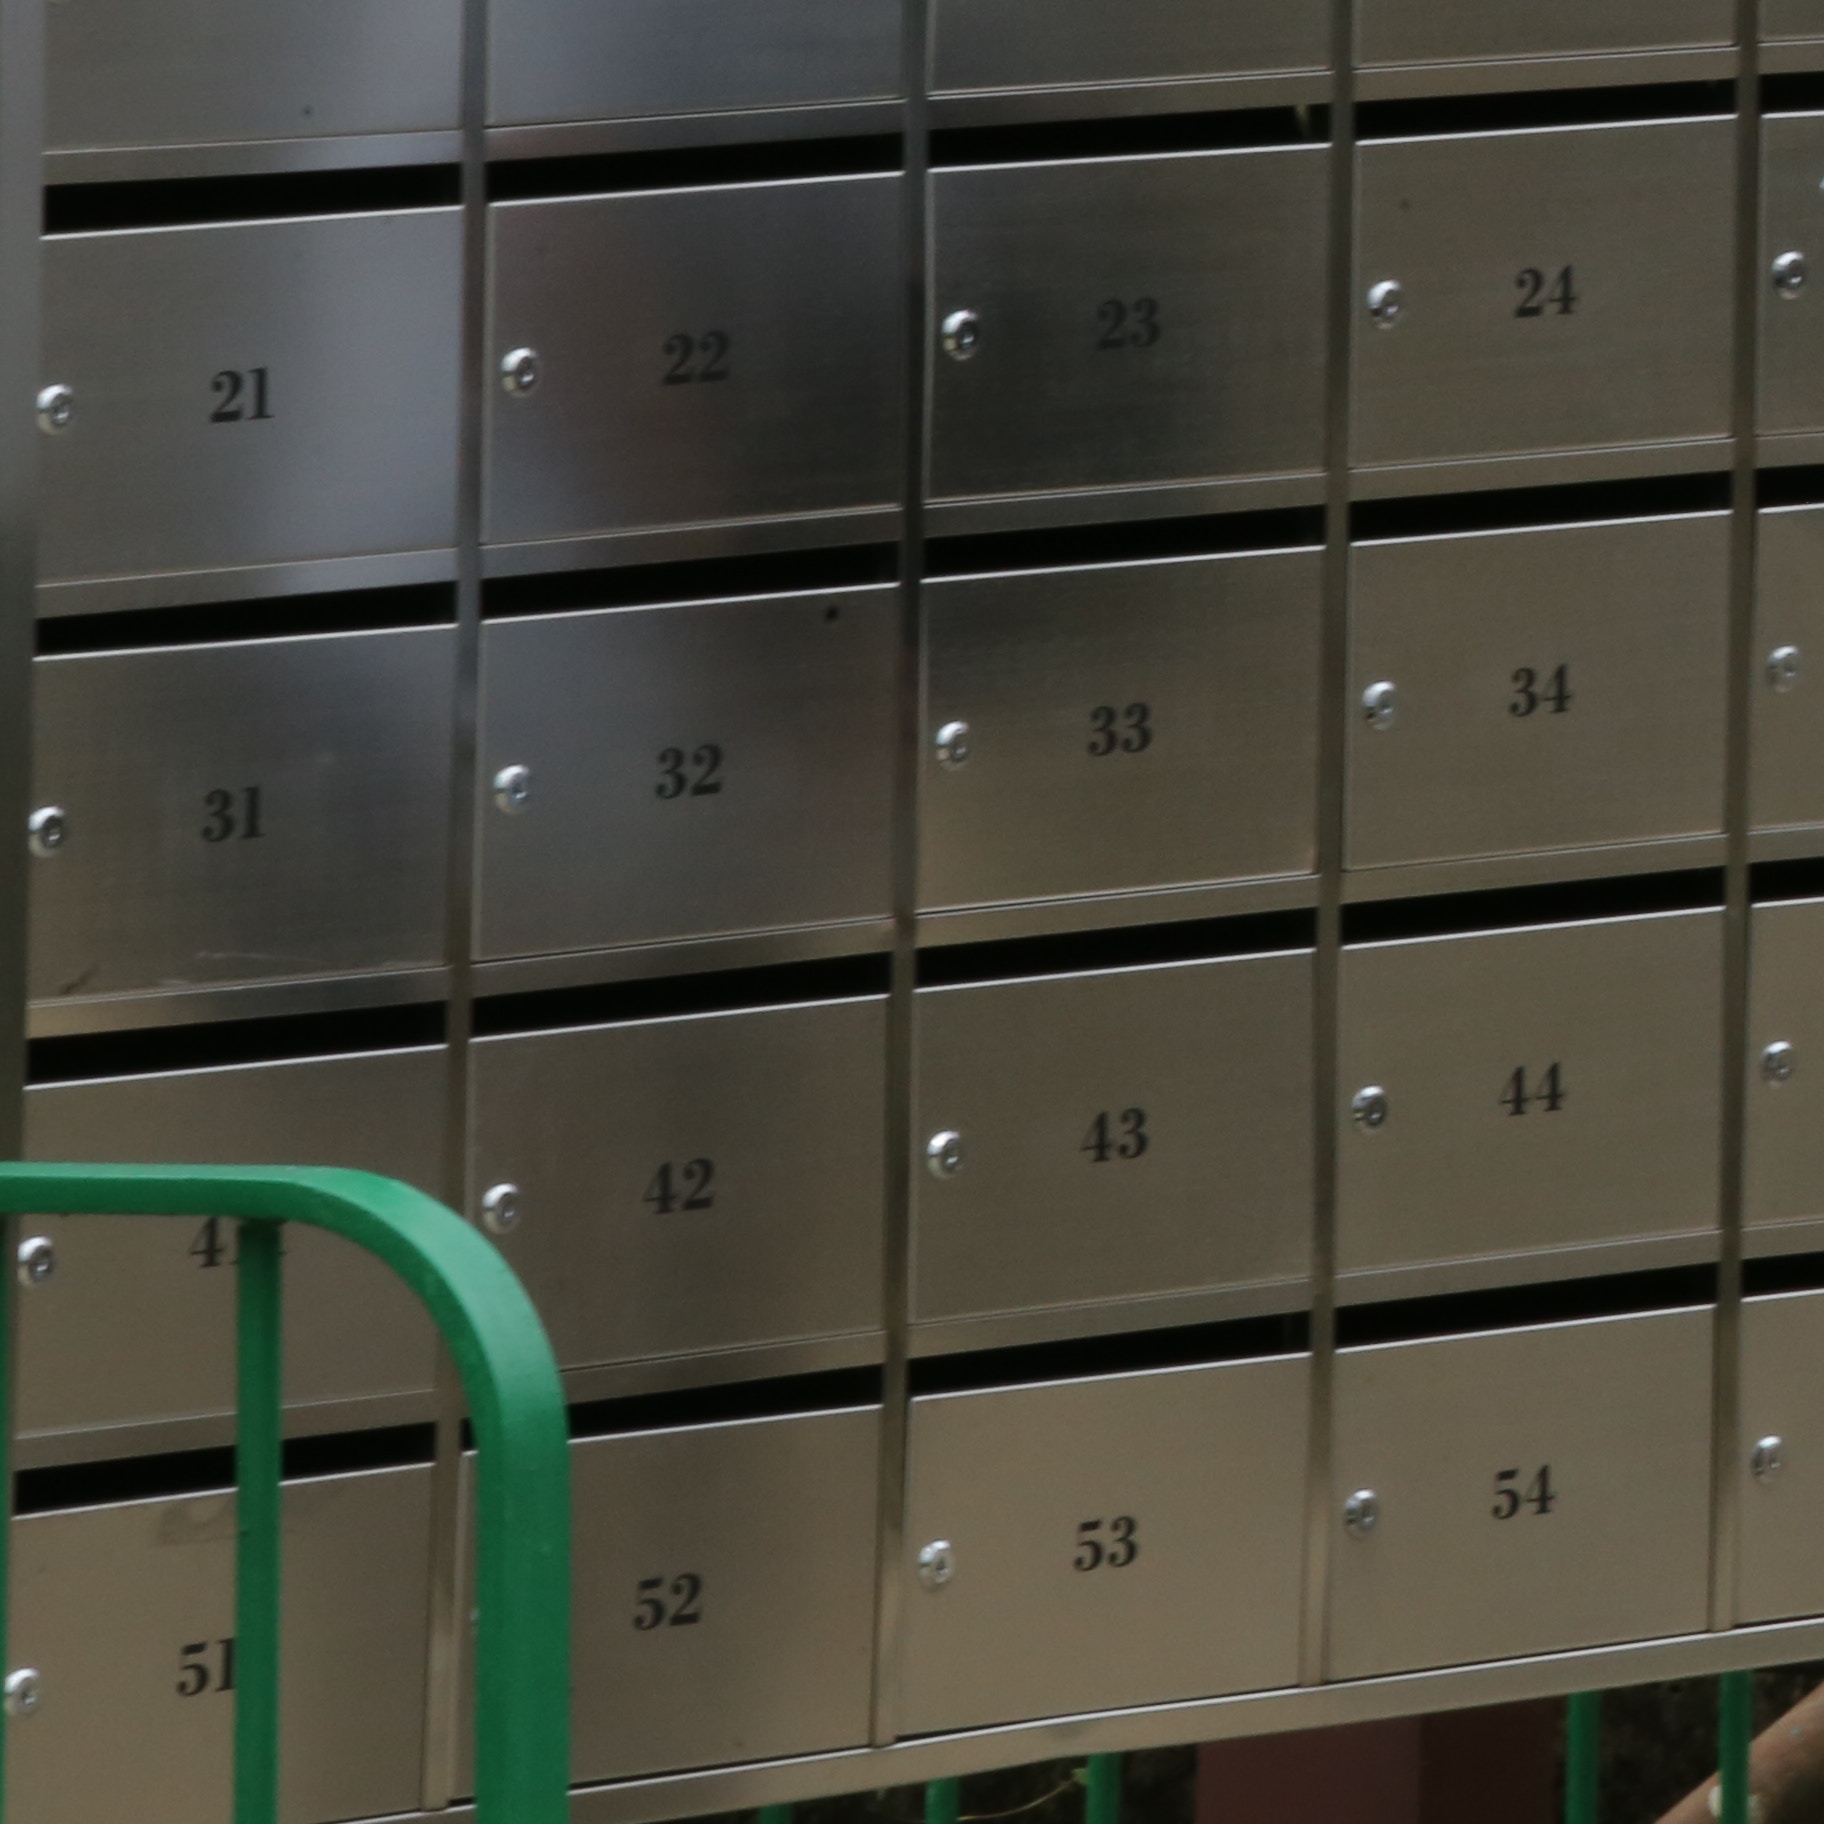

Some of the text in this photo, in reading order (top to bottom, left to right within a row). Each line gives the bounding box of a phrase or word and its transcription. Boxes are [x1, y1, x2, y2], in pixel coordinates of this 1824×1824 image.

[1514, 265, 1578, 318] 24
[1096, 297, 1162, 350] 23
[662, 330, 730, 386] 22
[210, 368, 273, 423] 21
[1509, 664, 1572, 717] 34
[1087, 703, 1152, 756] 33
[655, 744, 723, 799] 32
[201, 786, 263, 843] 31
[1500, 1063, 1565, 1116] 44
[1081, 1108, 1149, 1163] 43
[644, 1158, 714, 1214] 42
[1492, 1465, 1555, 1520] 54
[1073, 1516, 1138, 1572] 53
[633, 1573, 702, 1631] 52
[176, 1636, 238, 1697] 51
